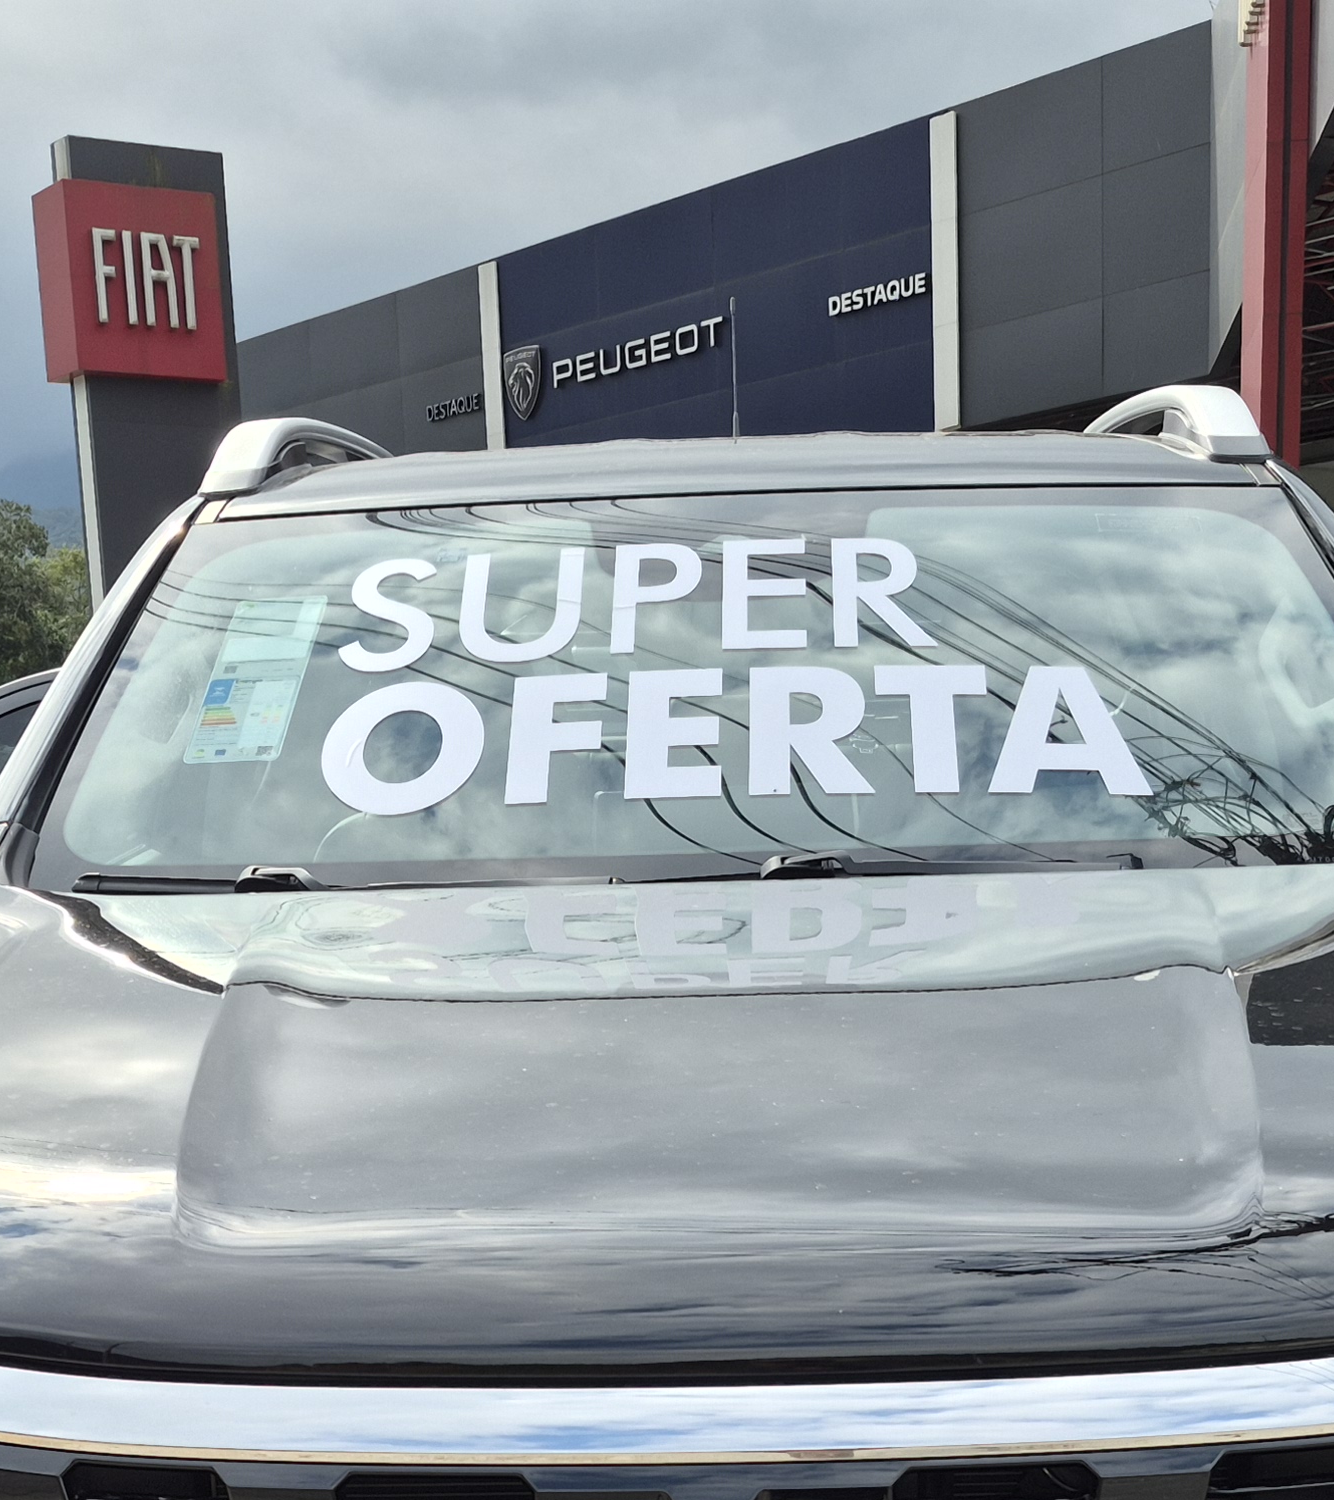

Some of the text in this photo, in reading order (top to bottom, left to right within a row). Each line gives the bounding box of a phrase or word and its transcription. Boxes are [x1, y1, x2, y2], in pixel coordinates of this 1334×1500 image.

[91, 226, 201, 331] FIAT
[827, 272, 927, 317] DESTAQUE
[505, 350, 536, 364] PEUGEOT
[552, 315, 723, 389] PEUGEOT
[425, 393, 481, 422] DESTAQUE
[336, 536, 939, 674] SUPER
[320, 663, 1153, 816] OFERTA
